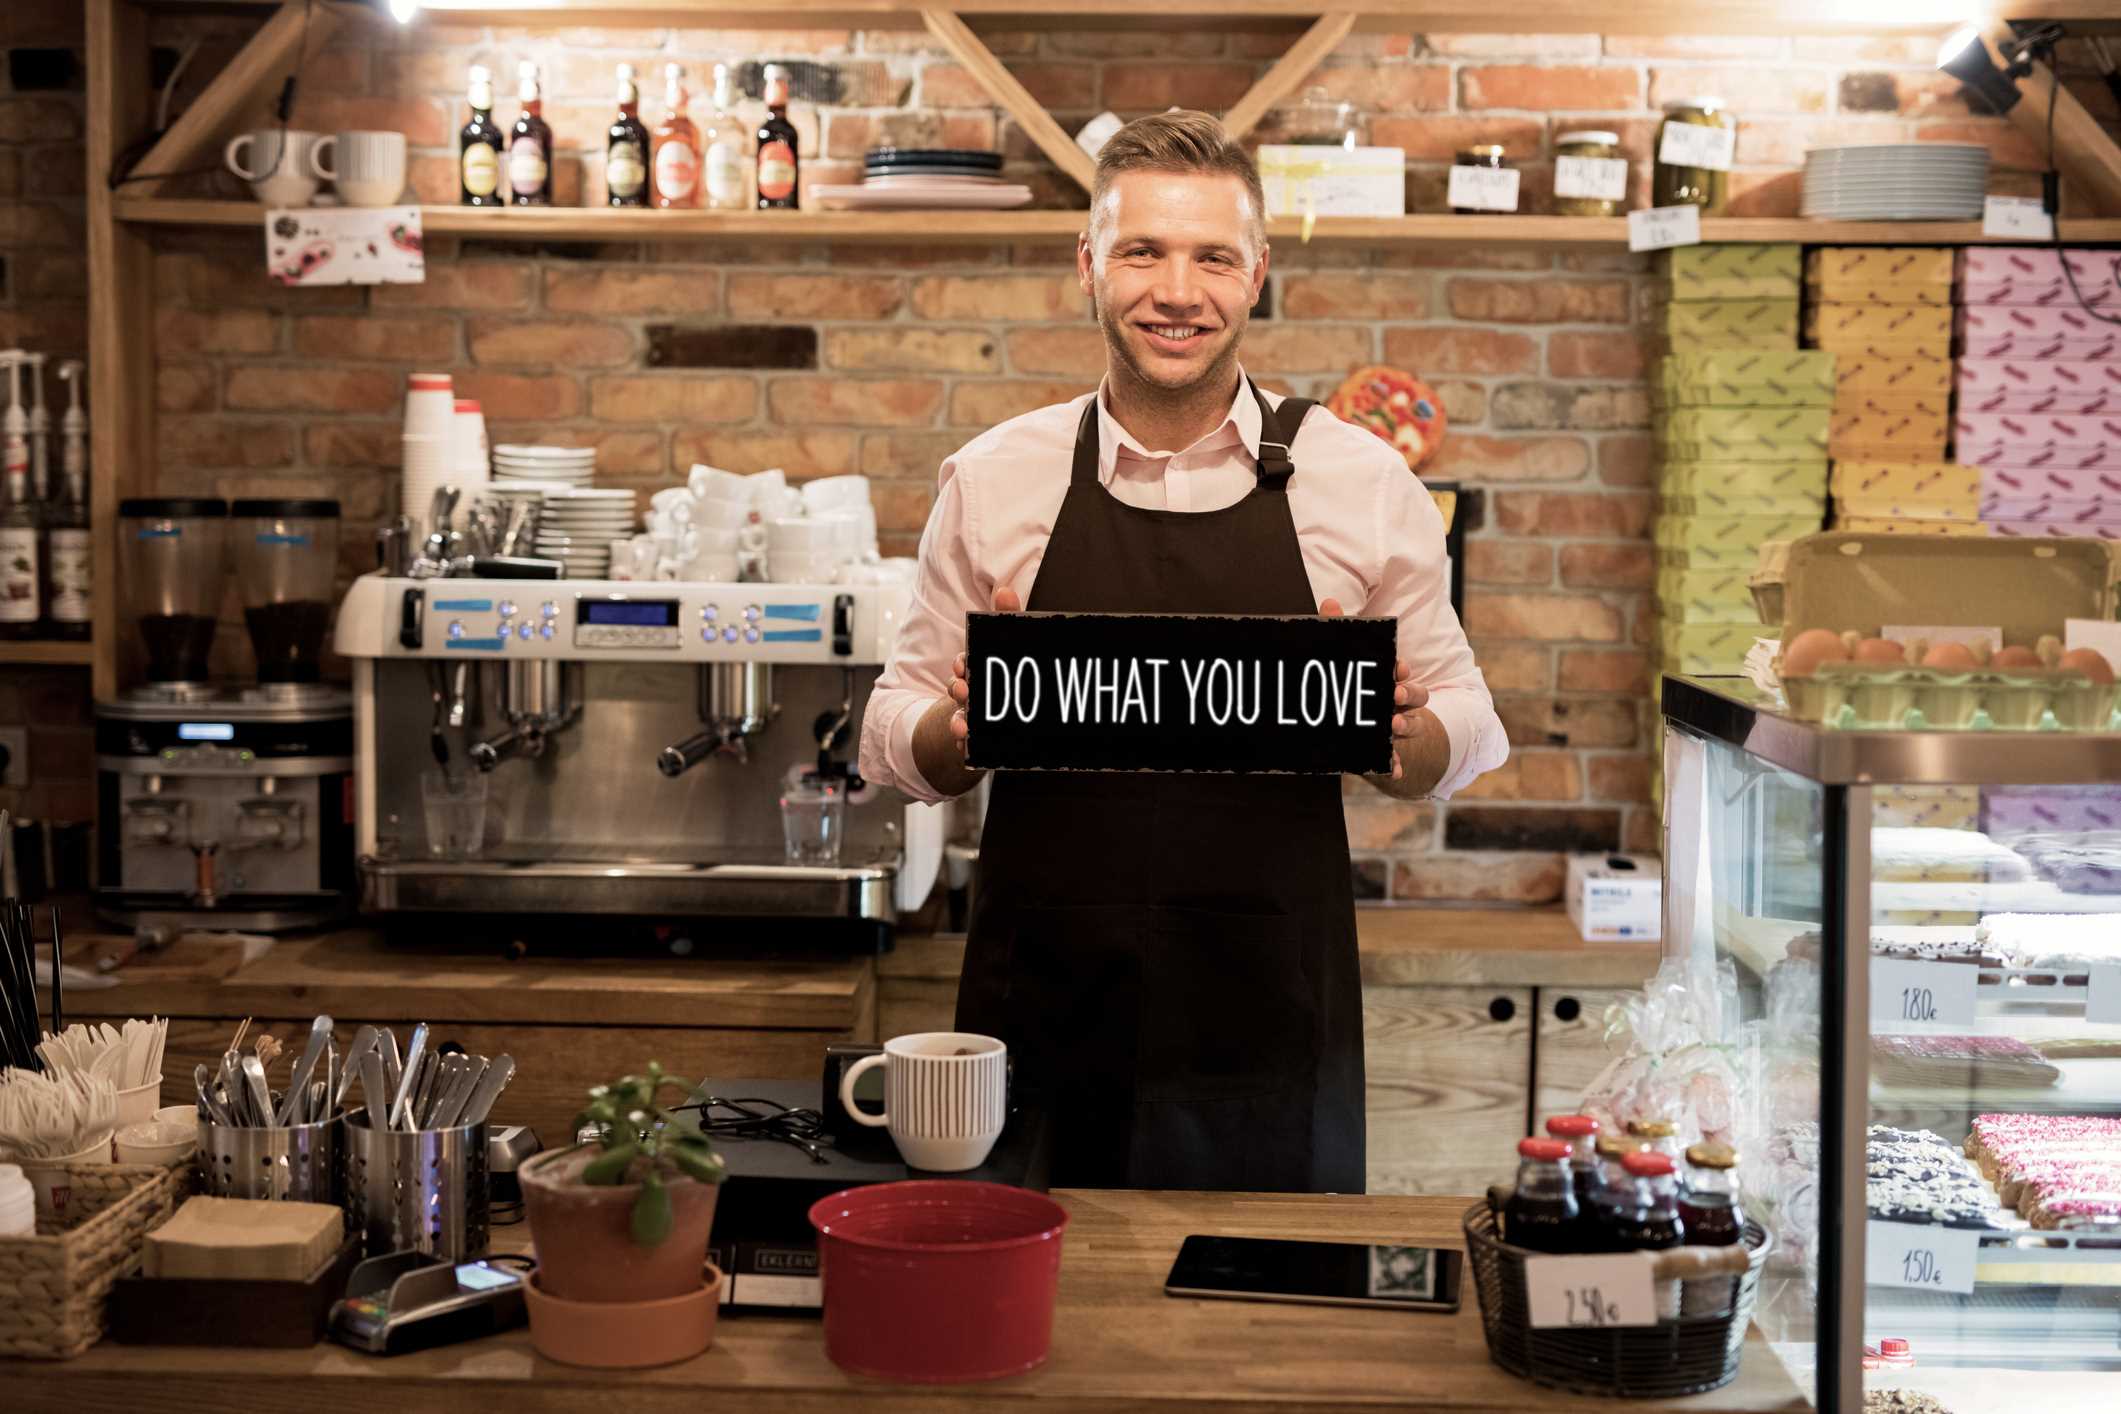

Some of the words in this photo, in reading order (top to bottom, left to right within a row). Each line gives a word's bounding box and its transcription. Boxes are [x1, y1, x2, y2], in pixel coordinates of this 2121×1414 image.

[985, 655, 1041, 723] DO
[1054, 656, 1169, 724] WHAT
[1180, 657, 1261, 725] YOU
[1277, 658, 1378, 726] LOVE
